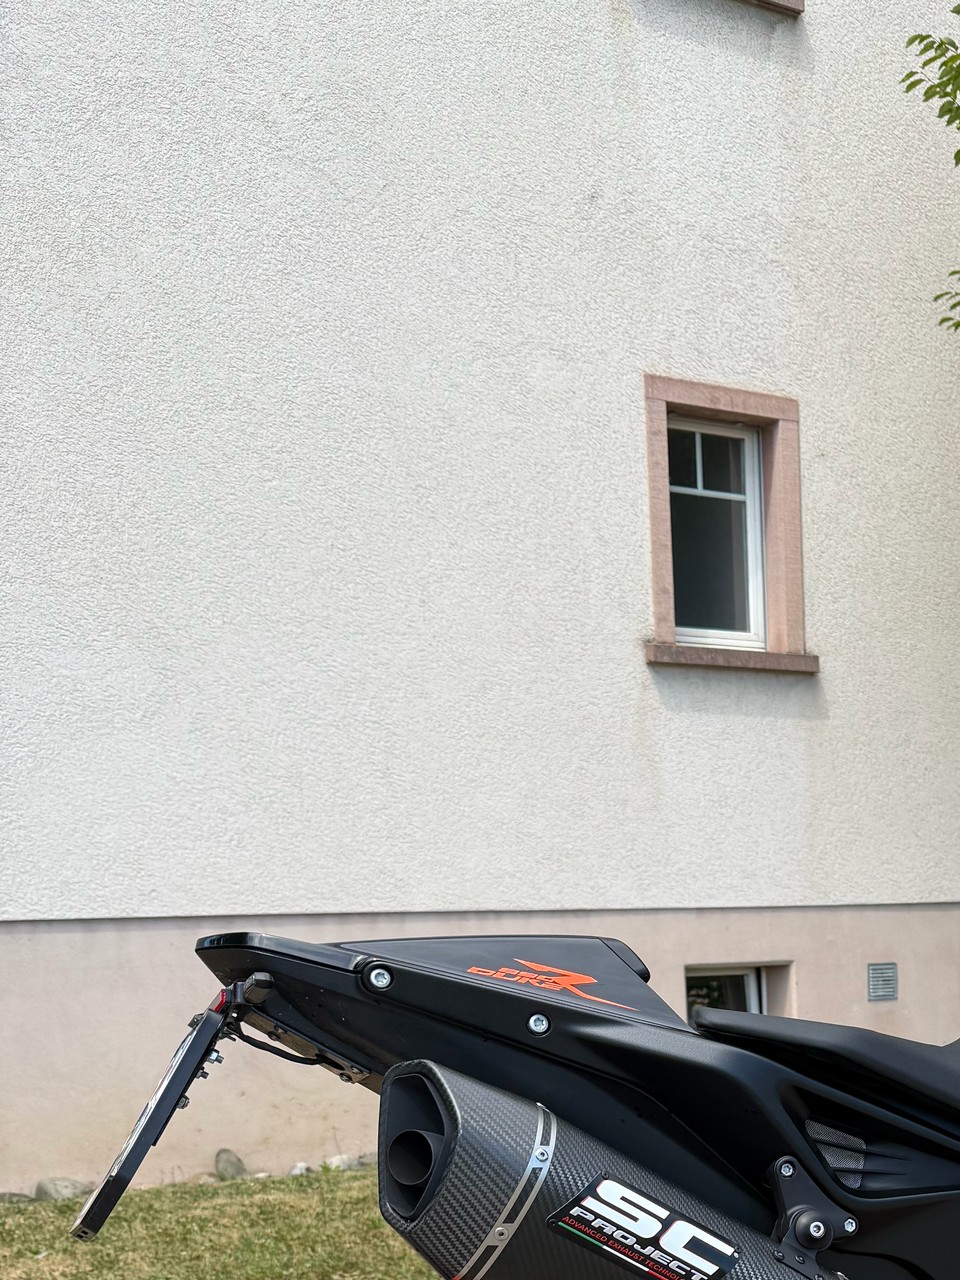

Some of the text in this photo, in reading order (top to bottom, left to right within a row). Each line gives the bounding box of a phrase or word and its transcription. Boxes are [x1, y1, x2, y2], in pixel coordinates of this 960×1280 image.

[466, 966, 563, 991] DUKE
[562, 1216, 607, 1243] ADVANCED
[607, 1240, 645, 1262] EXHAUST
[579, 1179, 736, 1276] SC
